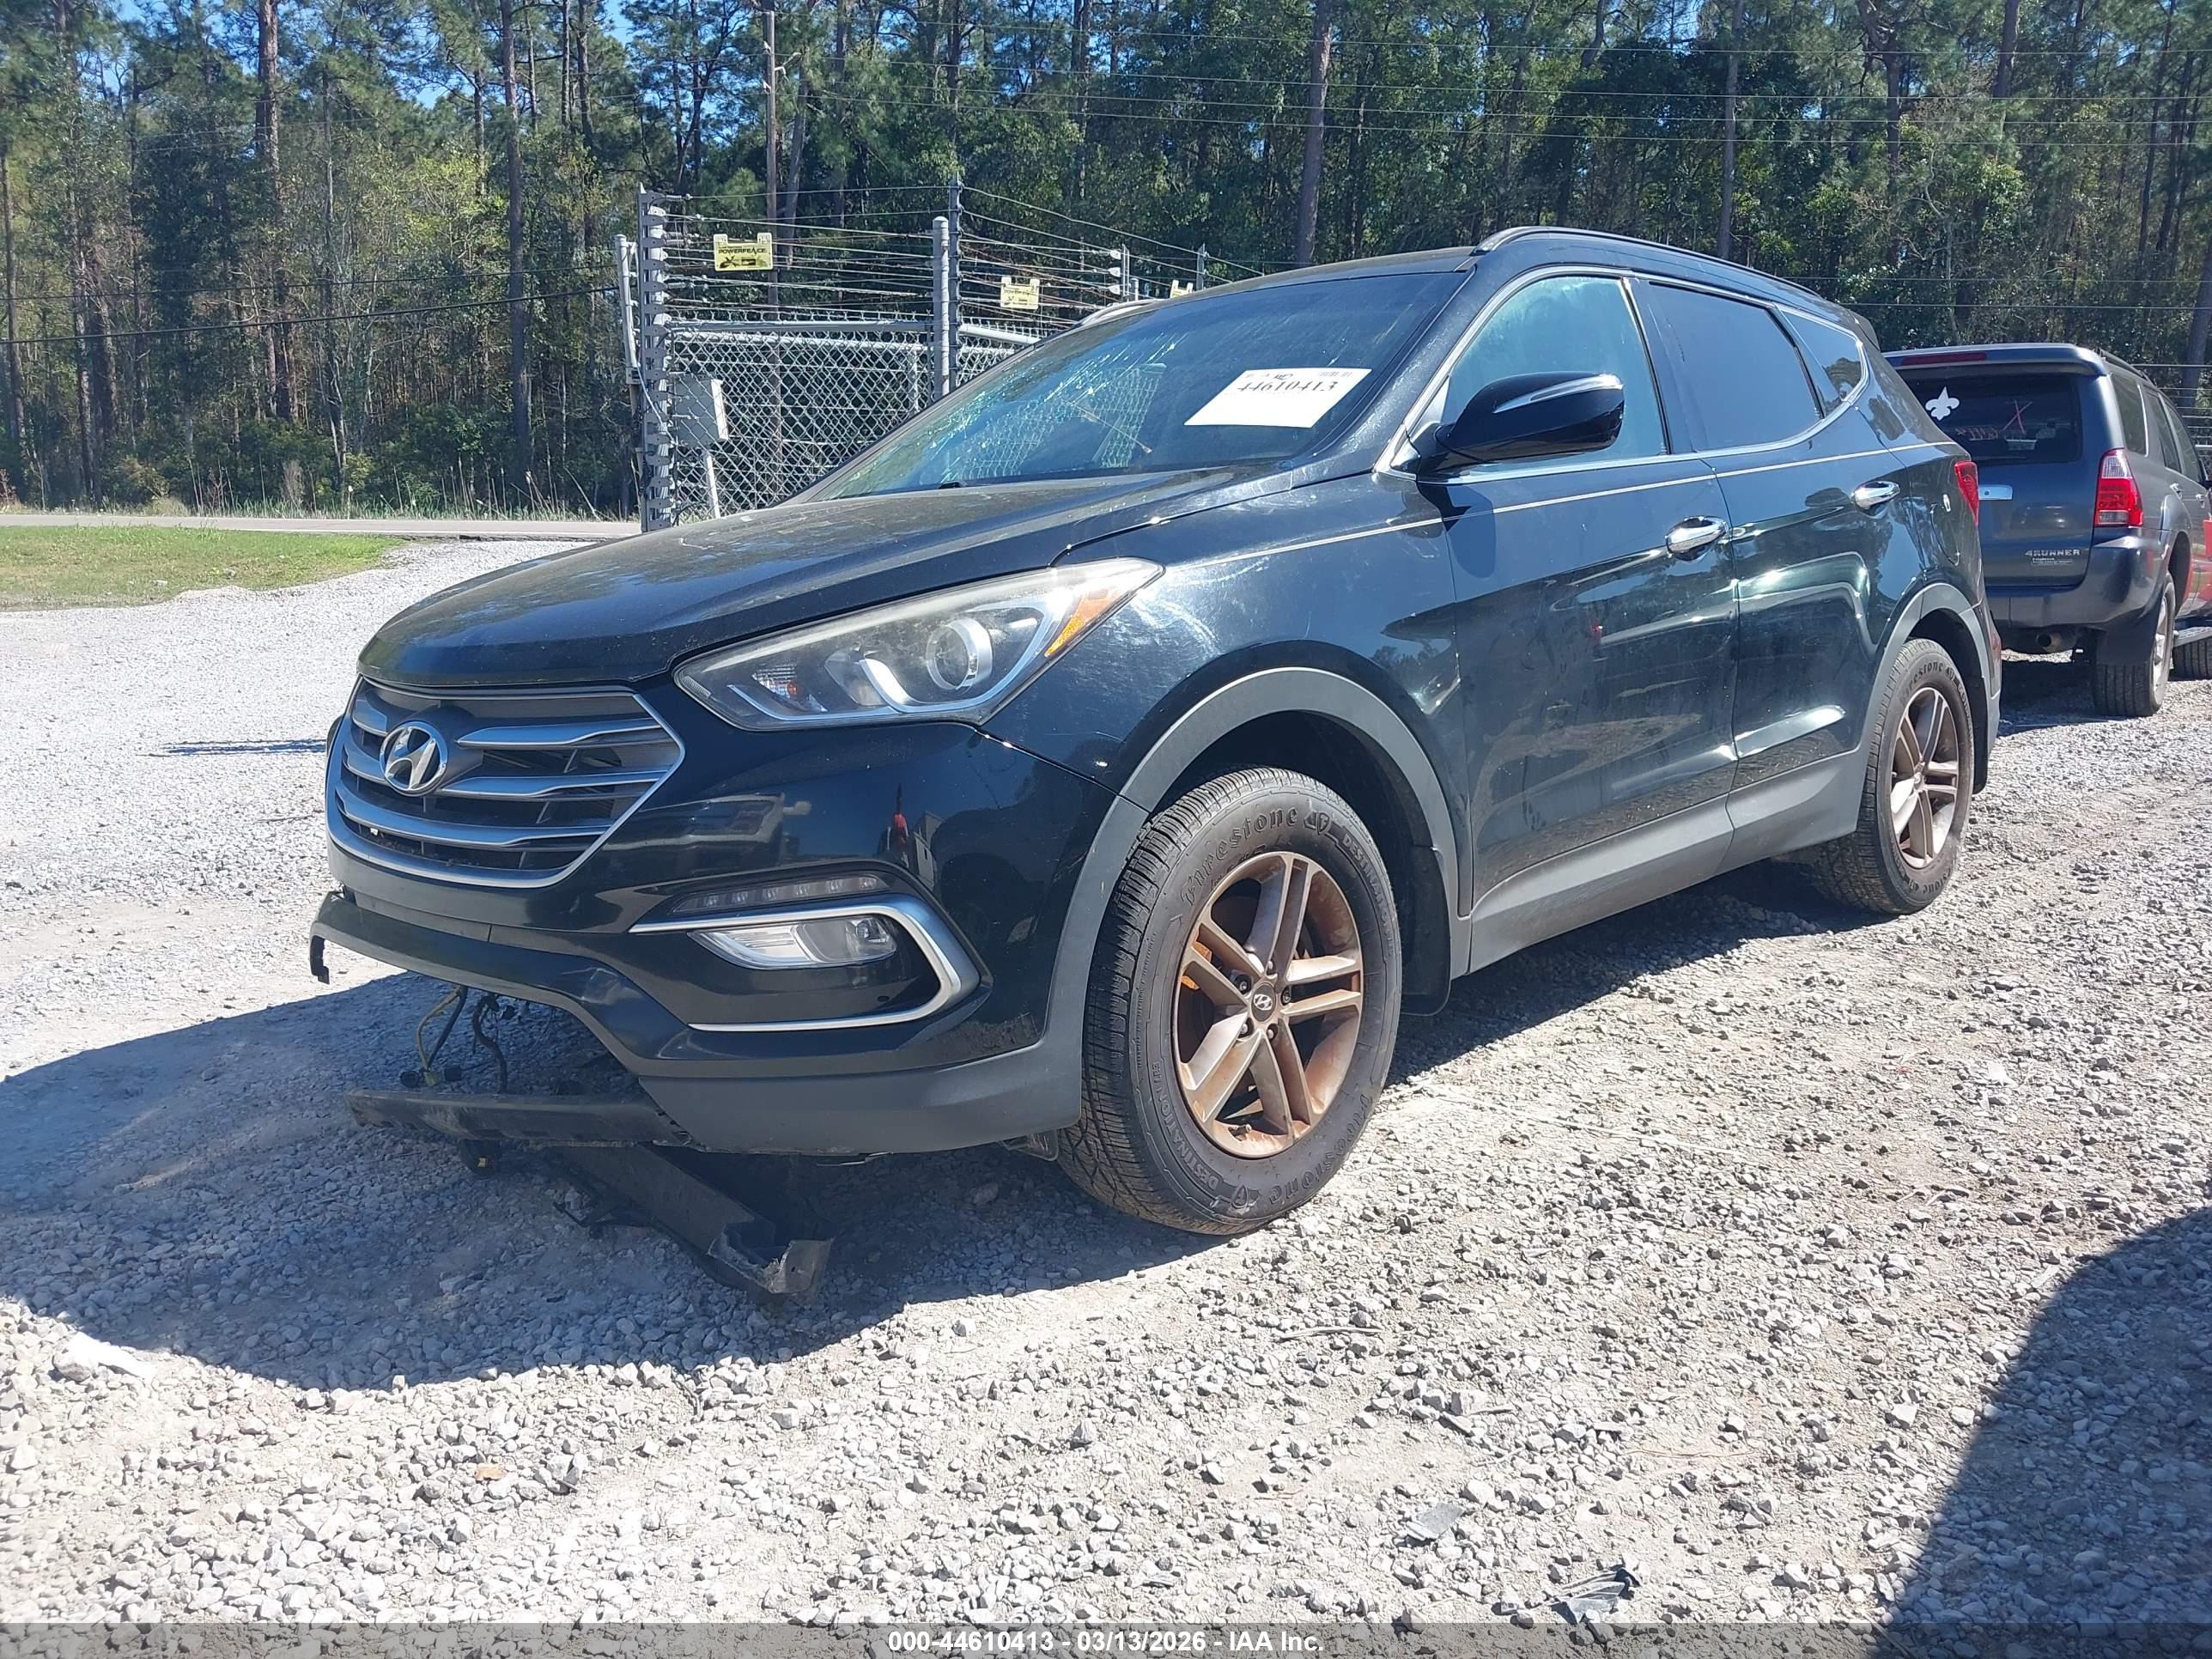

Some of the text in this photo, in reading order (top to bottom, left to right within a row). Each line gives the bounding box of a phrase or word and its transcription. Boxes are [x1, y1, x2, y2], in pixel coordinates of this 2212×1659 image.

[1237, 380, 1339, 391] 44610413
[2025, 549, 2081, 557] 4RUNNER
[1180, 805, 1299, 907] Firestone
